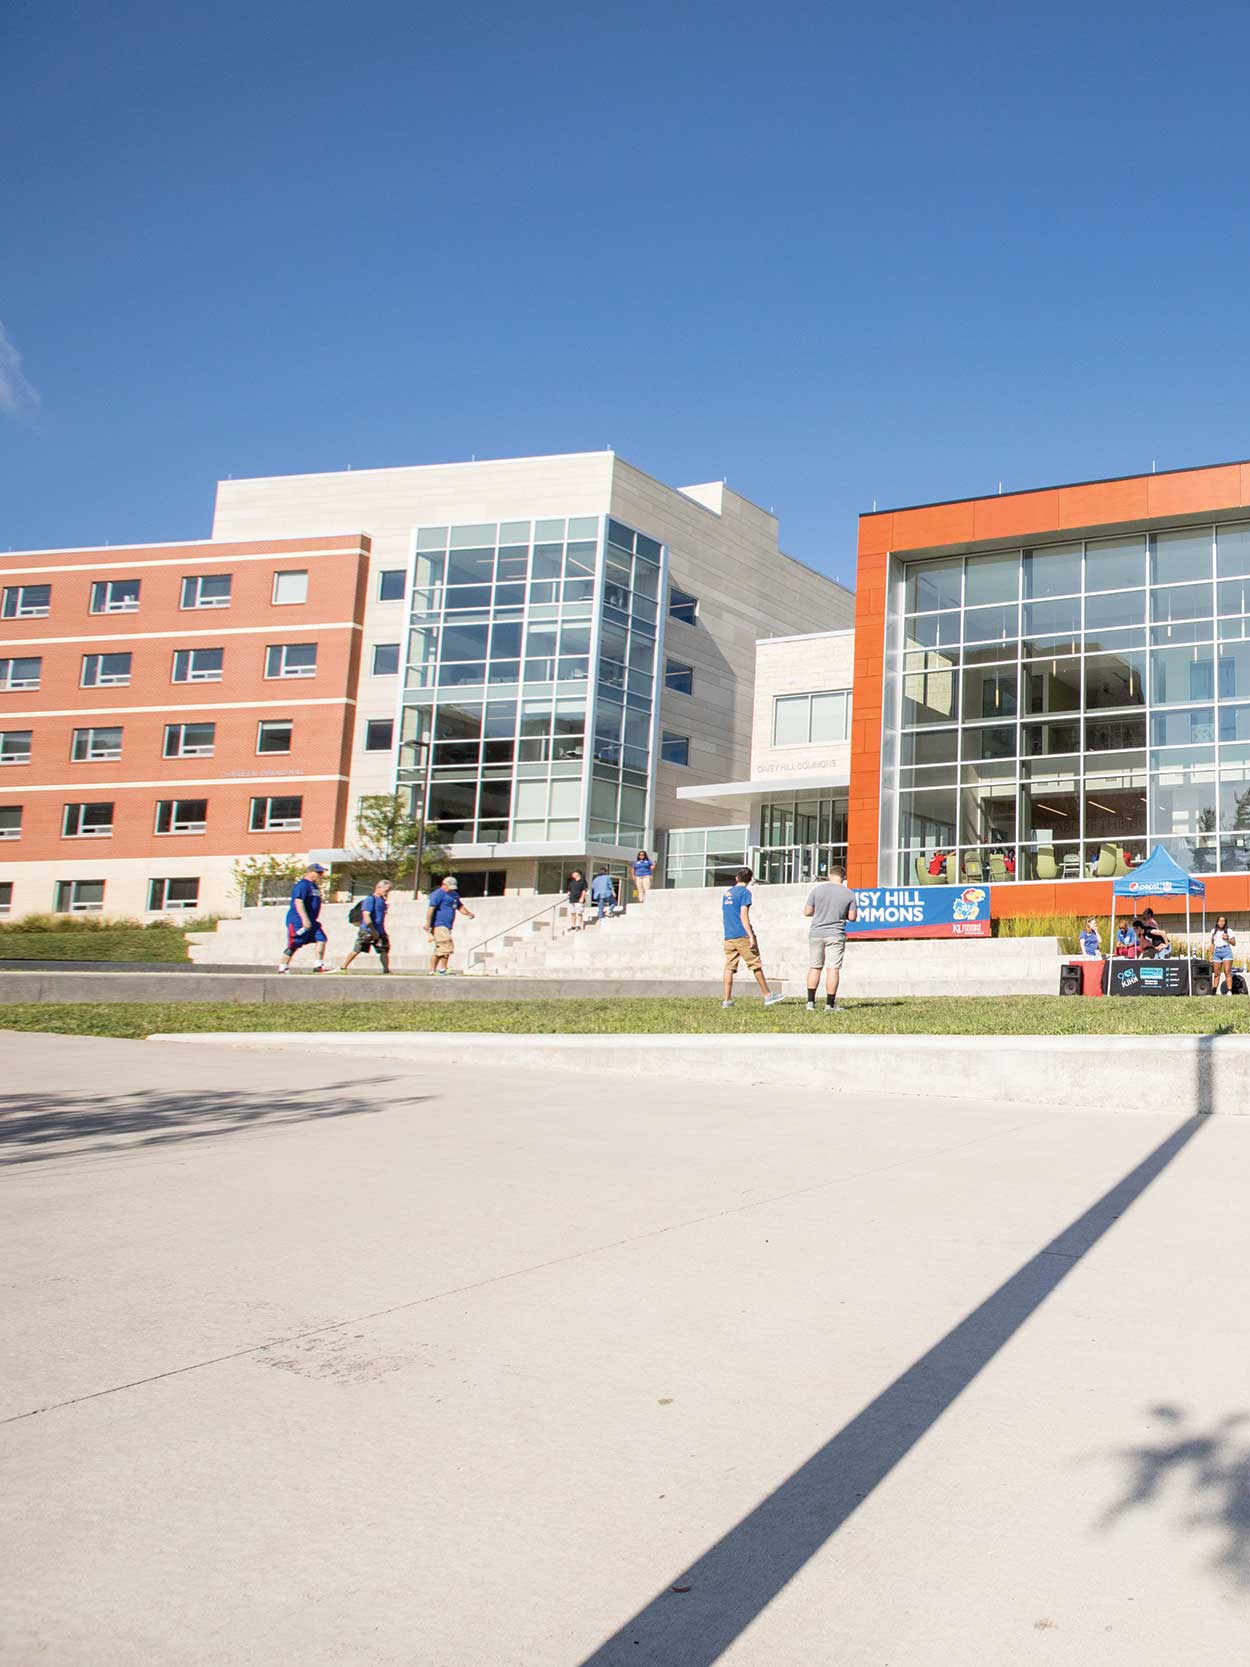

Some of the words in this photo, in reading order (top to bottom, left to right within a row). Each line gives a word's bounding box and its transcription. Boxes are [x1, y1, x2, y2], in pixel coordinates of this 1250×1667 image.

[855, 891, 881, 906] ISY
[885, 890, 925, 906] HILL
[855, 907, 924, 922] MMONS
[953, 923, 965, 934] KU
